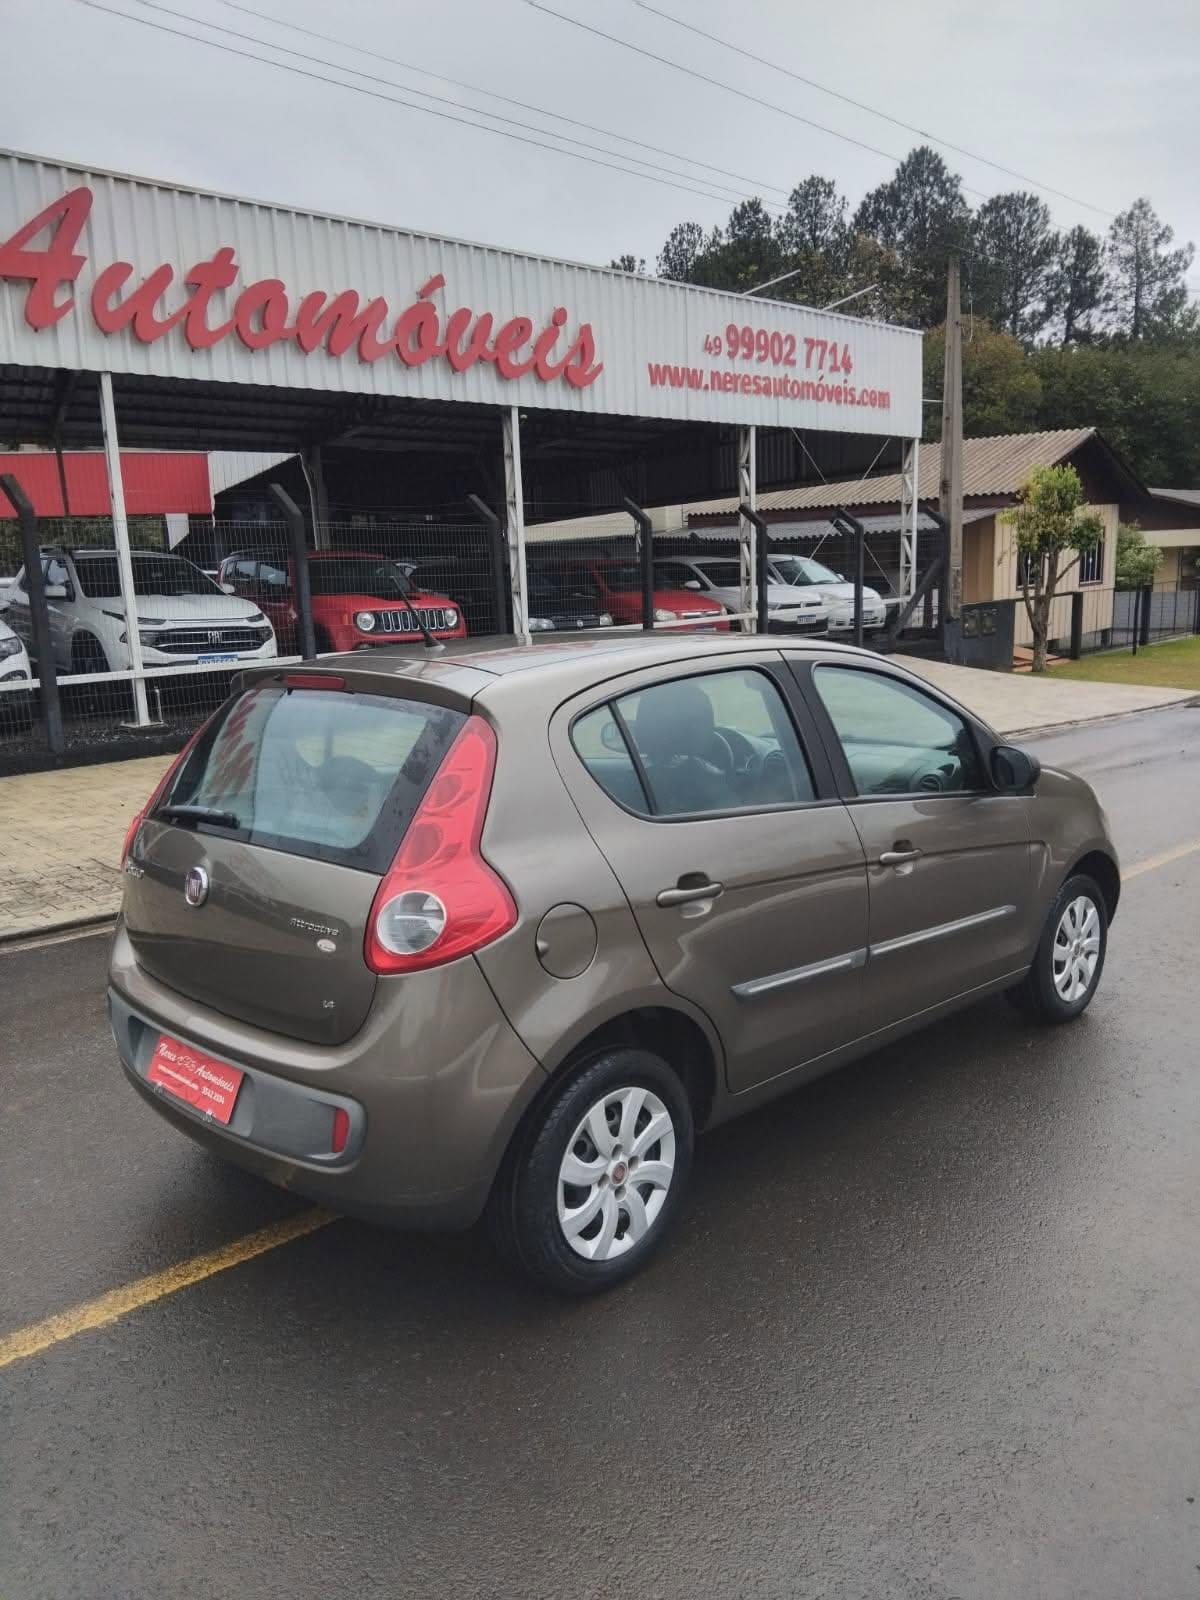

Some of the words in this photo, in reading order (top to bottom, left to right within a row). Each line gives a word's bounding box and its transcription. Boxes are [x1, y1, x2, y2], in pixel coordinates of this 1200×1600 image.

[0, 186, 604, 388] Automóveis
[703, 334, 723, 356] 49
[725, 323, 797, 367] 99902
[803, 336, 853, 374] 7714
[648, 362, 892, 410] www.neresautomóveis.com
